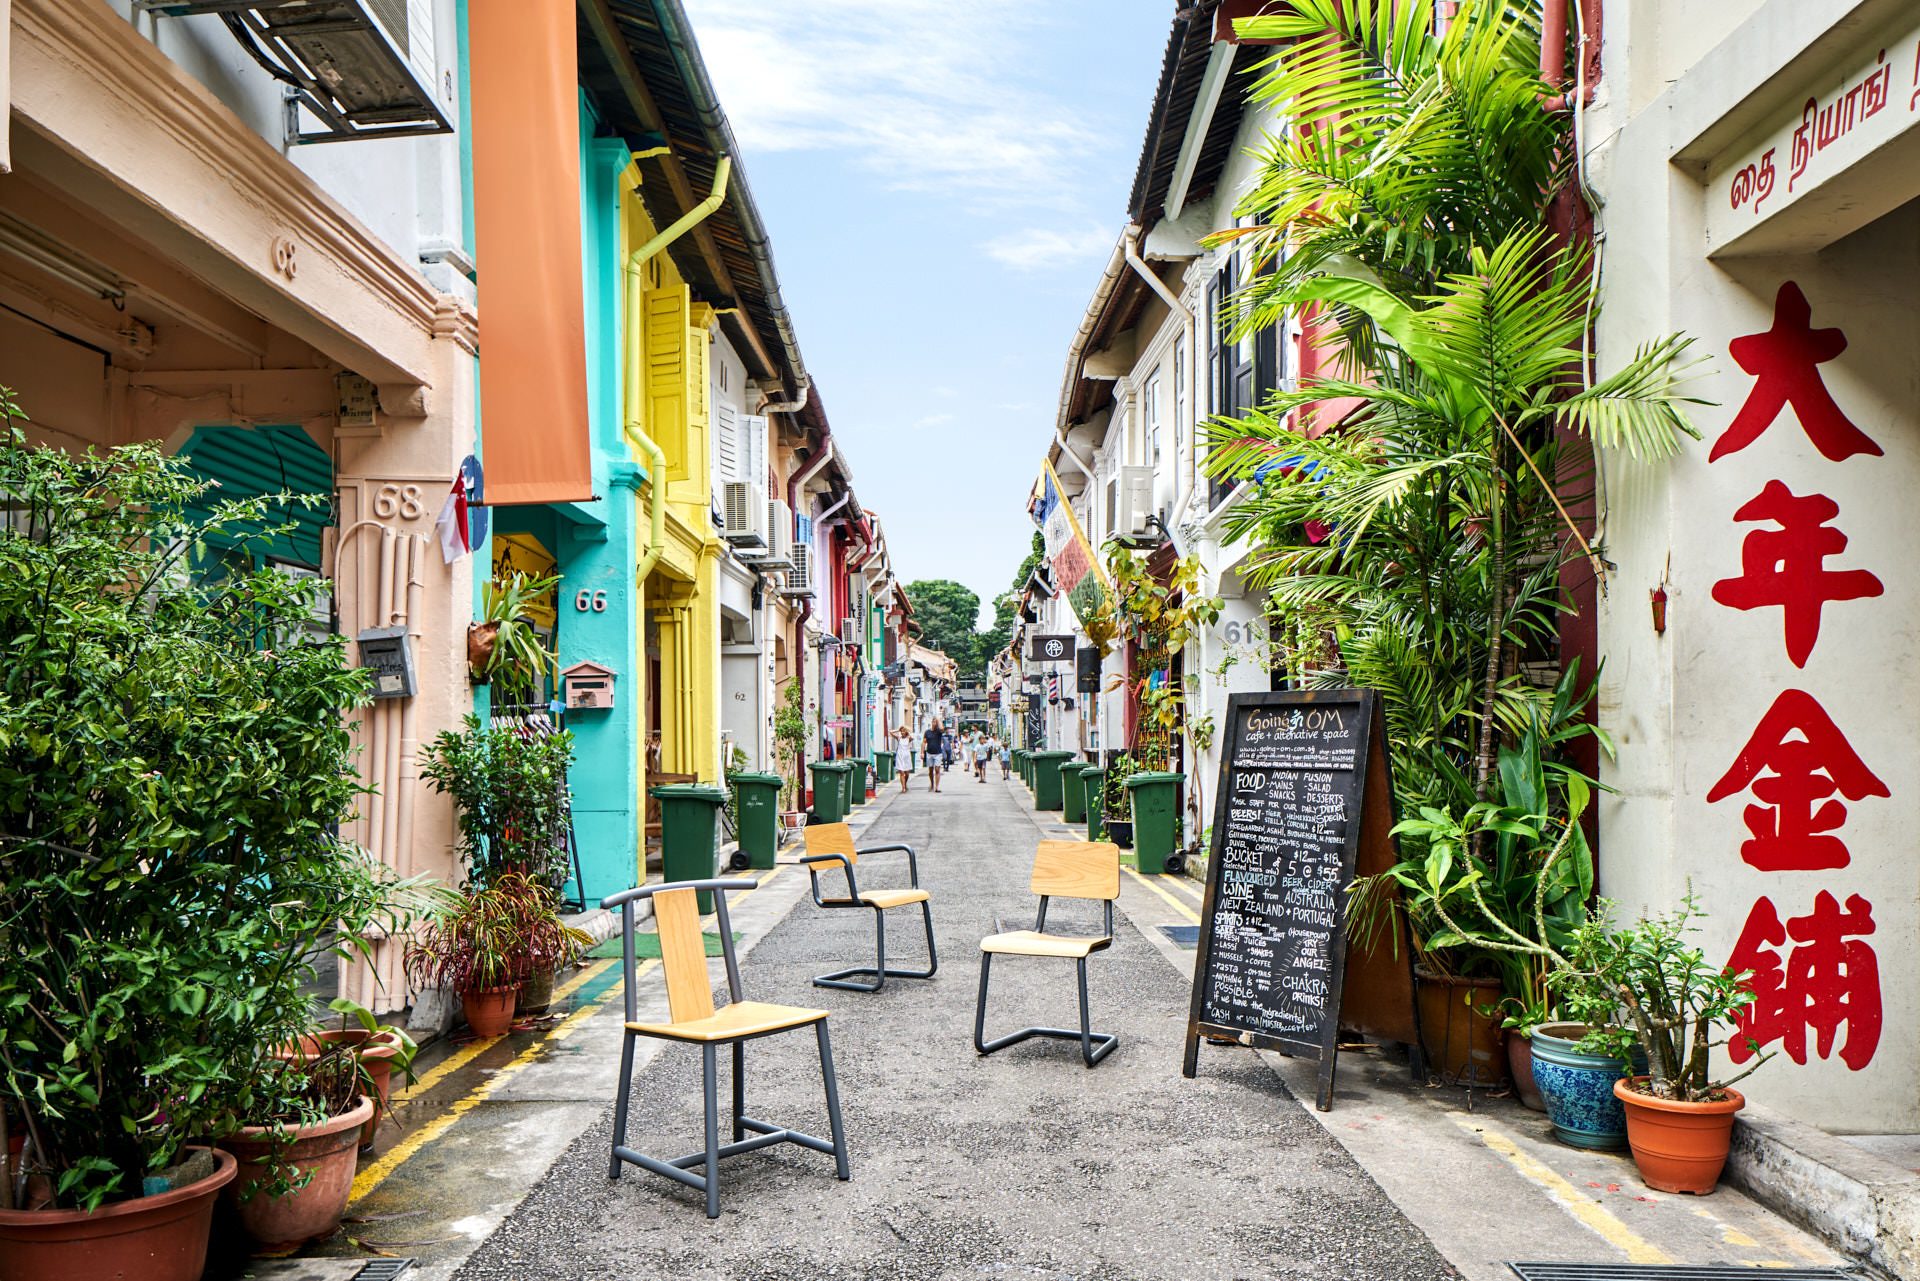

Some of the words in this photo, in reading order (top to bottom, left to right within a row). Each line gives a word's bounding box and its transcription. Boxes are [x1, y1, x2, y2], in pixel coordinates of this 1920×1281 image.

[271, 236, 297, 281] 68
[373, 484, 424, 521] 68
[575, 588, 608, 613] 66
[1224, 620, 1252, 644] 61
[735, 691, 746, 701] 62
[1247, 708, 1290, 732] Going
[1306, 708, 1344, 730] OM
[1246, 730, 1265, 743] cafe
[1323, 730, 1349, 743] space
[1236, 773, 1265, 790] FOOD
[1272, 770, 1298, 781] INDIAN
[1304, 772, 1333, 783] FUSION
[1283, 803, 1297, 812] OUR
[1223, 847, 1263, 867] BUCKET
[1224, 870, 1276, 886] FLAVOURED
[1287, 861, 1297, 876] 5
[1303, 865, 1312, 878] @
[1317, 866, 1339, 882] $55
[1223, 882, 1254, 900] WINE
[1262, 888, 1278, 900] from
[1220, 899, 1240, 910] NEW
[1244, 901, 1284, 917] ZEALAND
[1293, 908, 1336, 927] PORTUGAL
[1301, 948, 1318, 957] OUR
[1303, 939, 1319, 948] TRY
[1292, 957, 1326, 970] ANGEL
[1282, 976, 1329, 995] CHAKRA
[1233, 996, 1248, 1007] have
[1211, 1008, 1230, 1020] CASH
